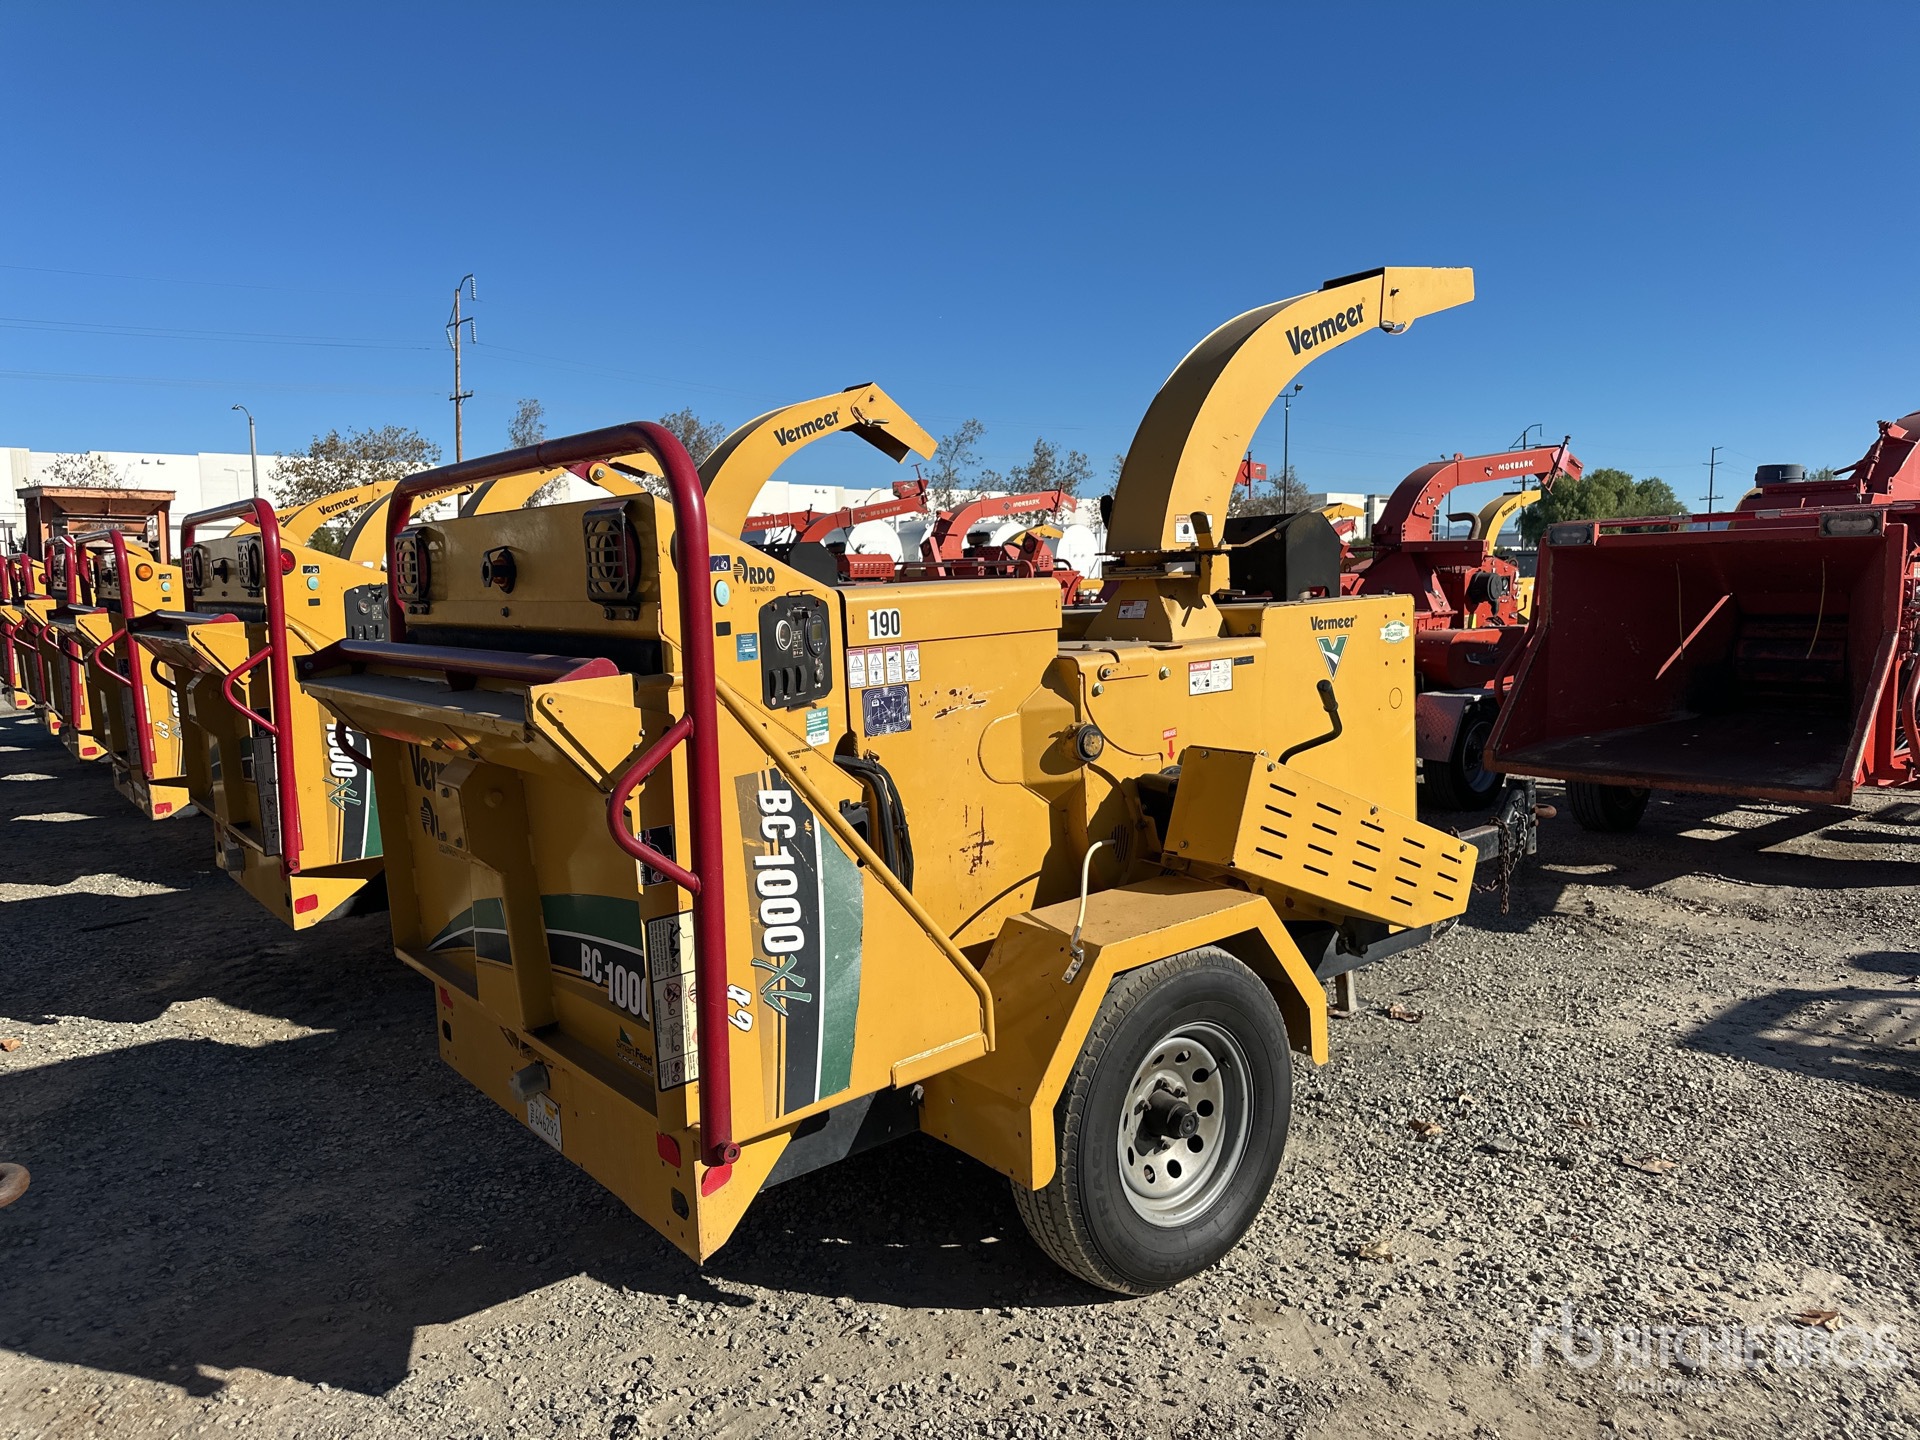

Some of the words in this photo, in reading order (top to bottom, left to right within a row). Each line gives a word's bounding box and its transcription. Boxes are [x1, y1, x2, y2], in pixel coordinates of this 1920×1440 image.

[1285, 303, 1364, 356] Vermeer
[773, 411, 839, 447] Vermeer
[1498, 459, 1534, 471] MORBARK
[317, 495, 359, 515] Vermeer
[870, 610, 900, 637] 190
[1310, 614, 1355, 631] Vermeer
